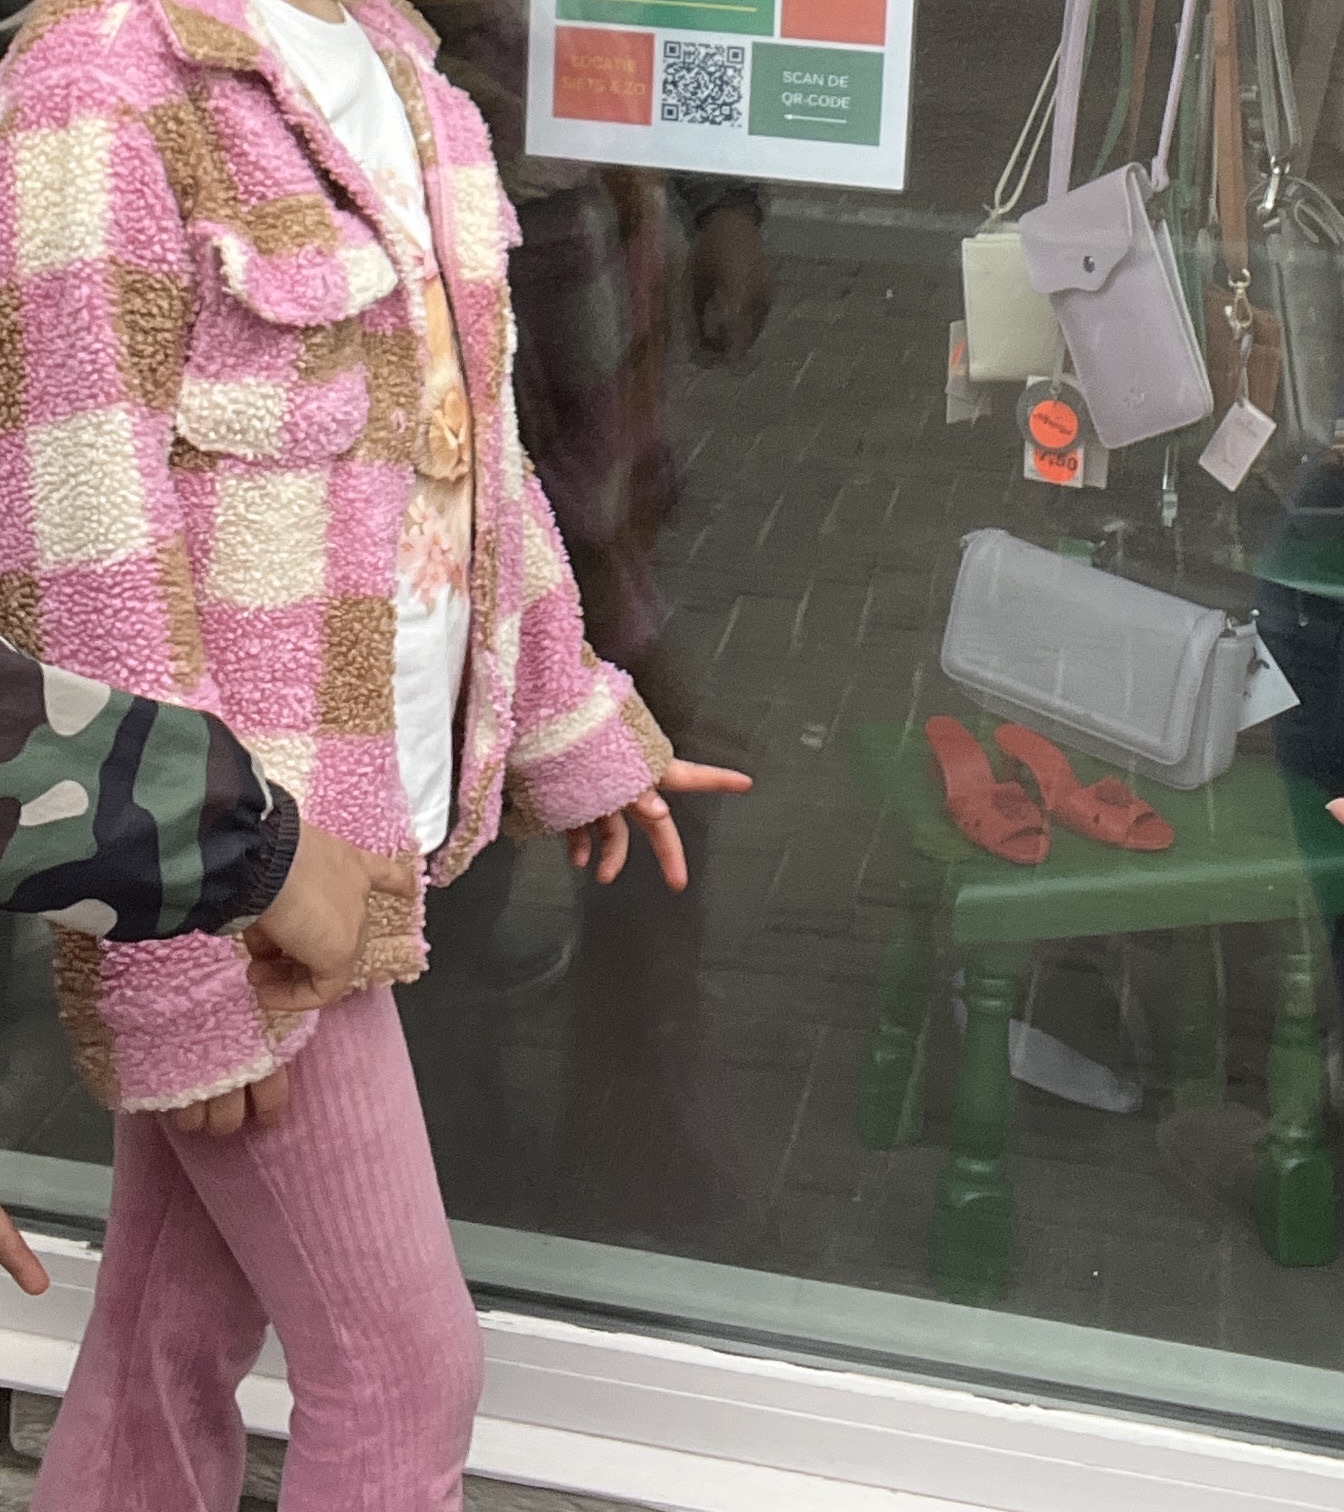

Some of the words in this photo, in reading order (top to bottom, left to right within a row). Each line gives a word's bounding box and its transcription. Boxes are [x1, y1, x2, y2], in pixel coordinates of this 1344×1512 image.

[782, 71, 824, 87] SCAN
[827, 74, 848, 88] DE
[781, 91, 851, 109] QR-CODE
